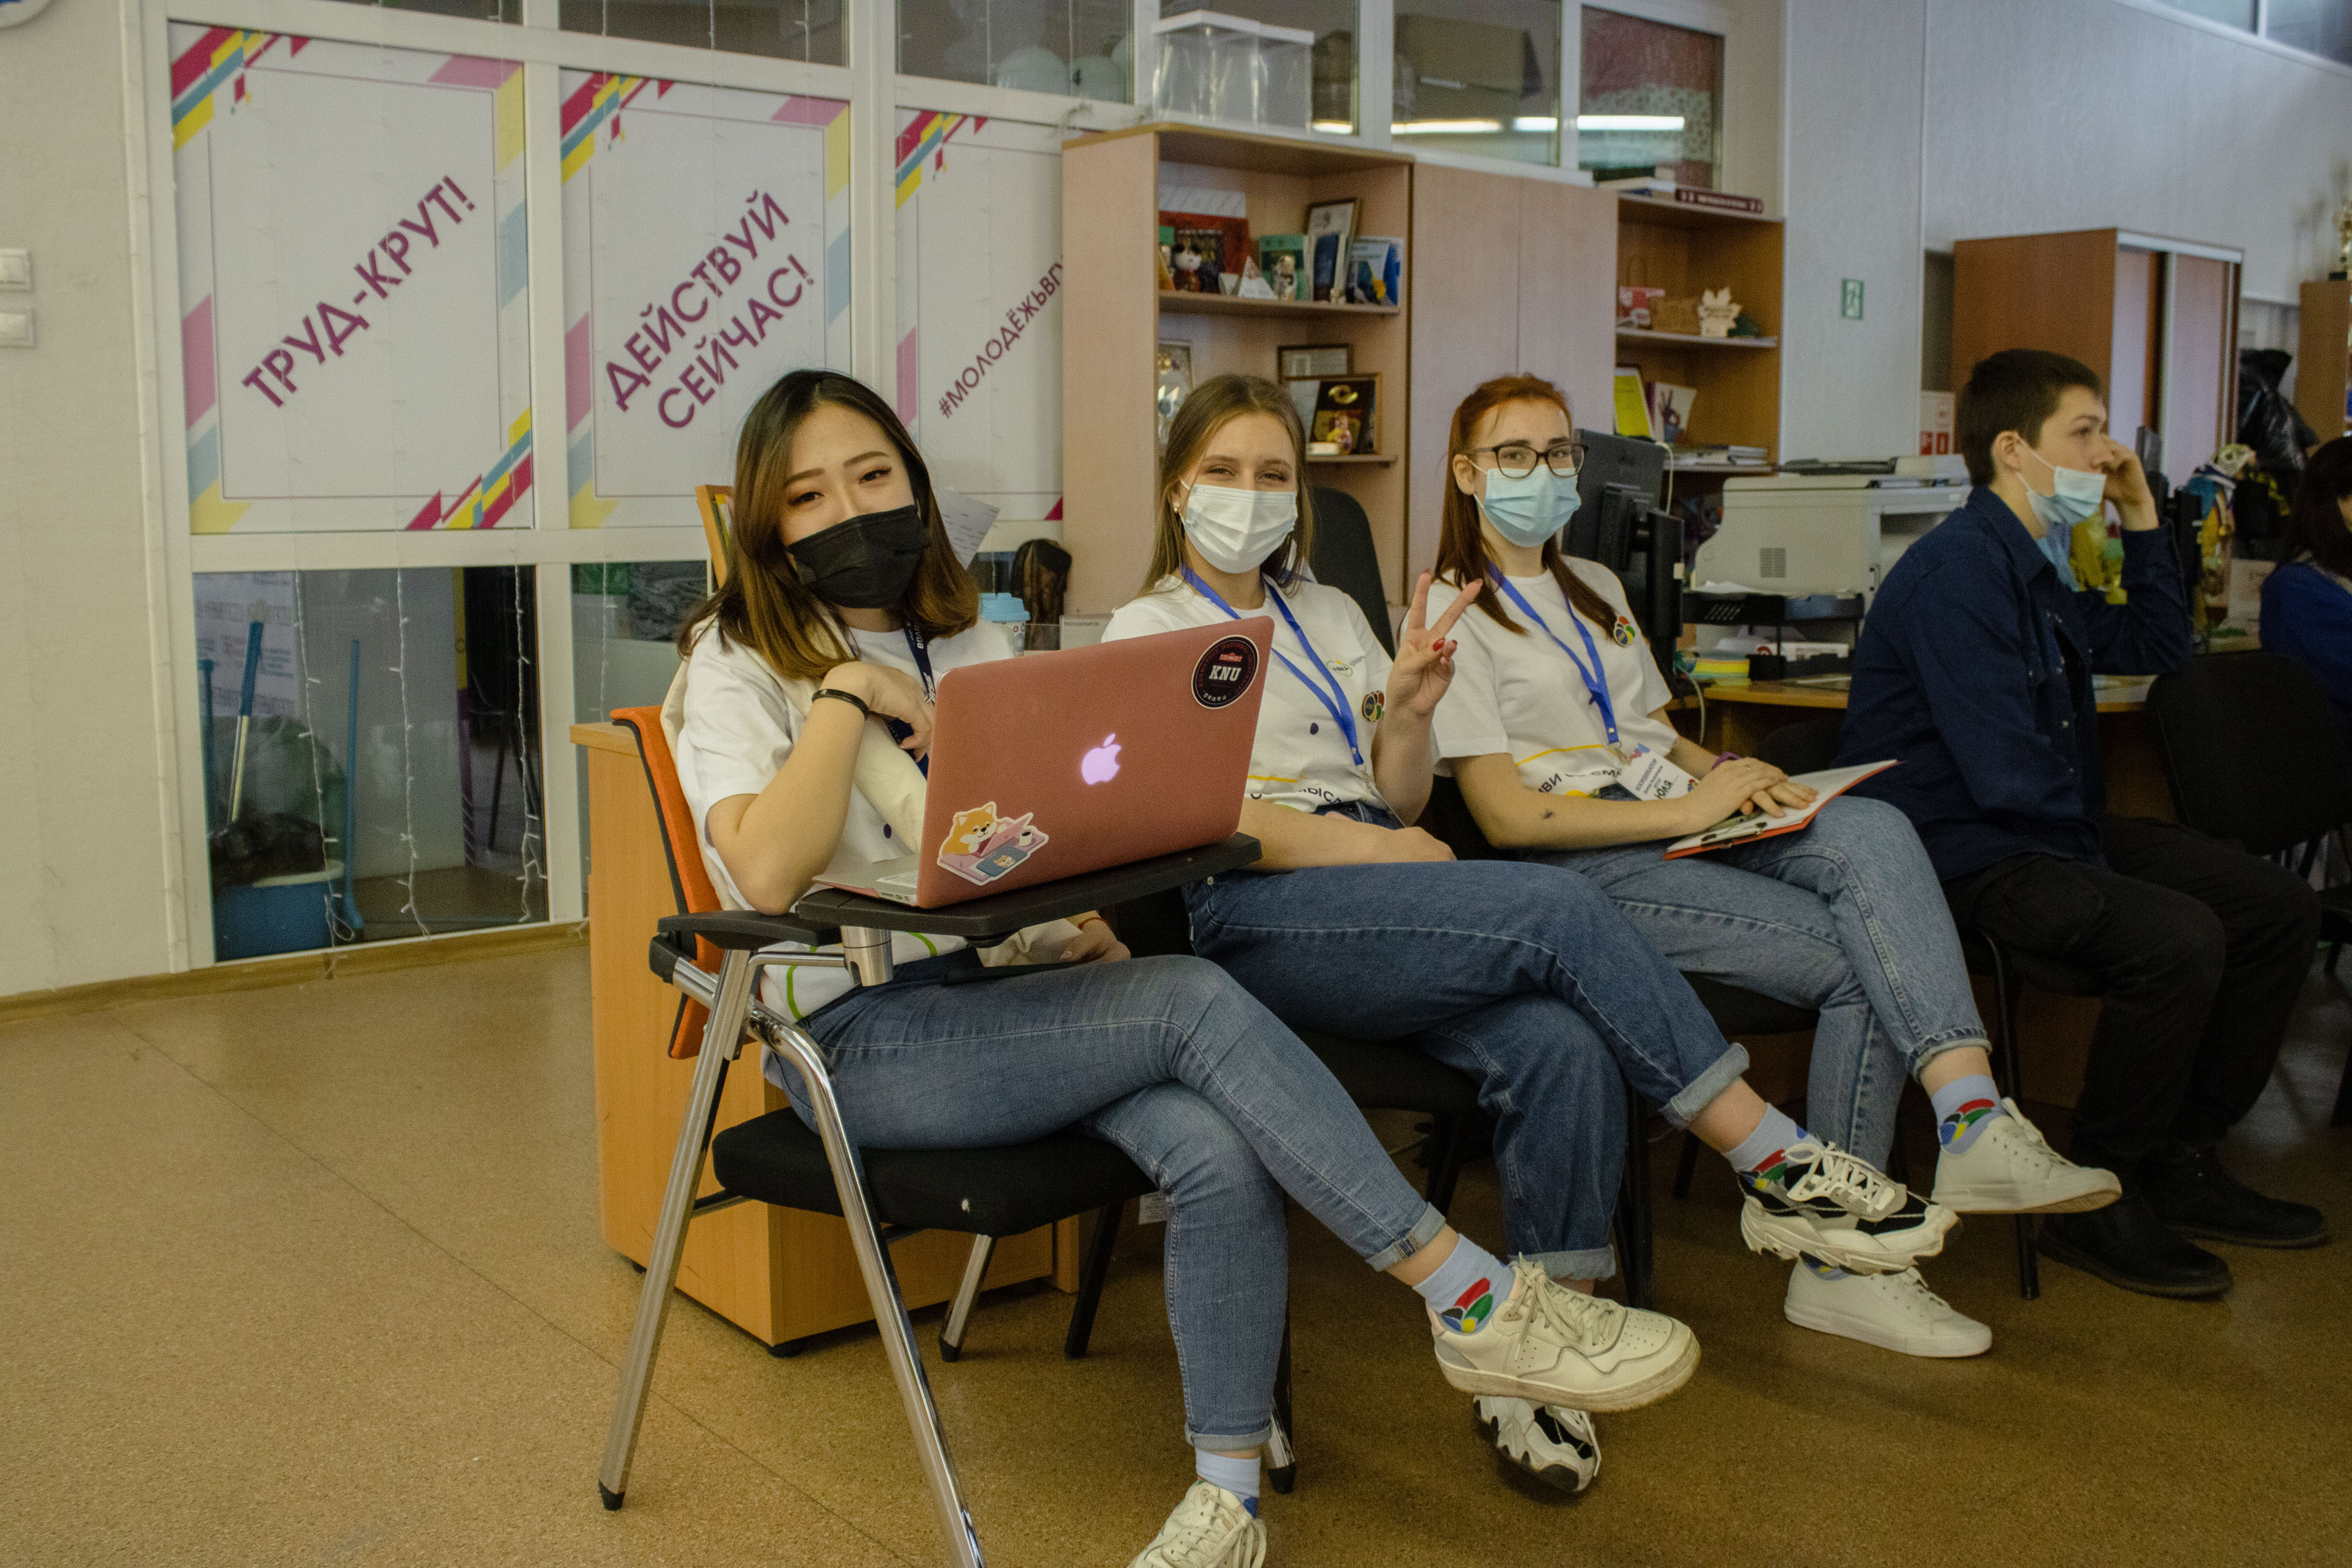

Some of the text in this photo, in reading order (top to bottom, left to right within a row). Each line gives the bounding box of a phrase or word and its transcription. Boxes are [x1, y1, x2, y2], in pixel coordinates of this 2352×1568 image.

[241, 175, 475, 408] ТРУД-КРУТ!
[605, 189, 790, 412] ДЕЙСТВУЙ
[657, 254, 815, 428] СЕЙЧАС!
[938, 260, 1062, 418] #МОЛОДЁЖЬВП
[1209, 665, 1242, 682] KNU
